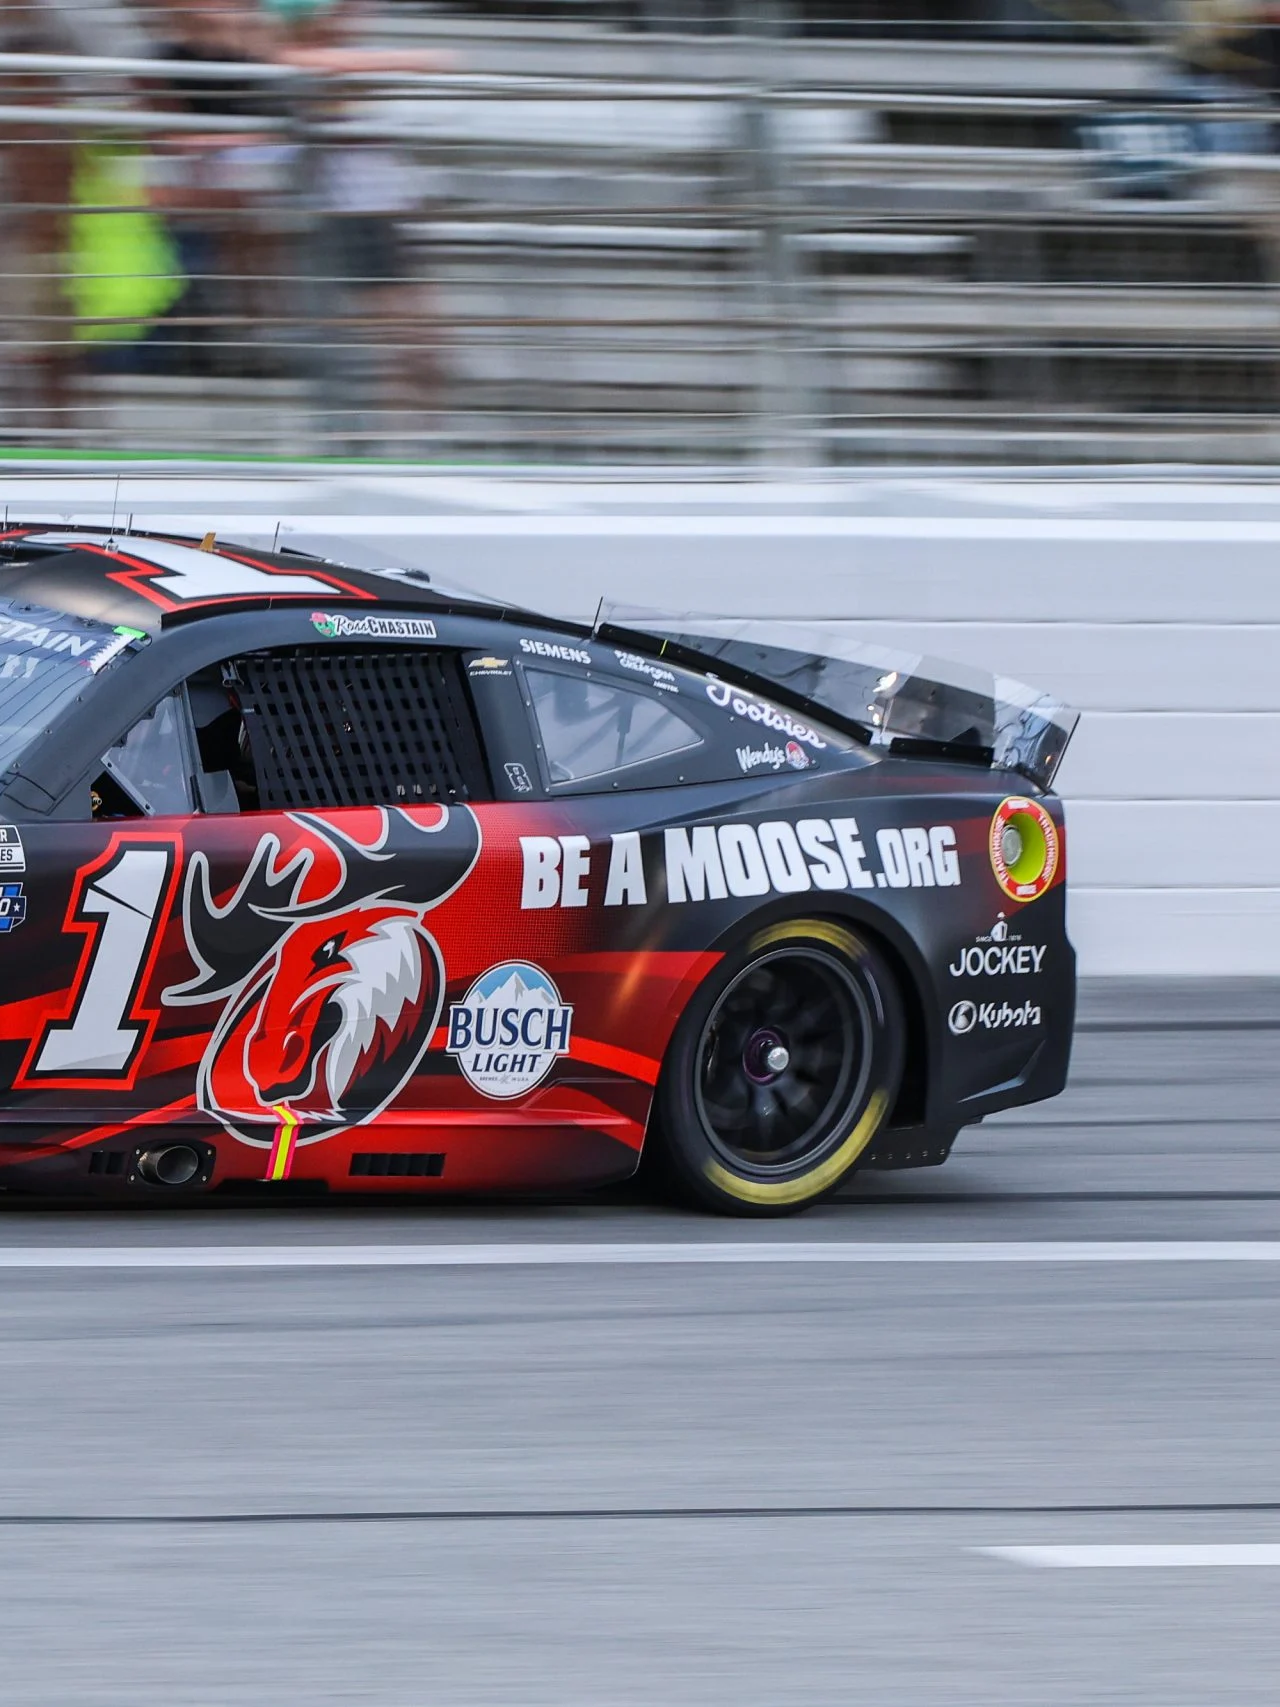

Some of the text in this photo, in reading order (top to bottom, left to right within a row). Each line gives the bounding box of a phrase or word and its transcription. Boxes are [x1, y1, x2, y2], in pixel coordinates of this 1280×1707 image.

[12, 530, 352, 603] 1
[333, 616, 434, 636] Ross CHASTAIN
[519, 638, 591, 664] SIEMENS
[705, 682, 827, 749] Tootsies
[736, 742, 786, 773] Wendy's
[519, 817, 961, 910] BE A MOOSE.ORG
[28, 844, 172, 1076] 1
[949, 944, 1048, 977] JOCKEY
[449, 1007, 570, 1050] BUSCH
[978, 999, 1041, 1029] Kubota
[471, 1053, 541, 1073] LIGHT
